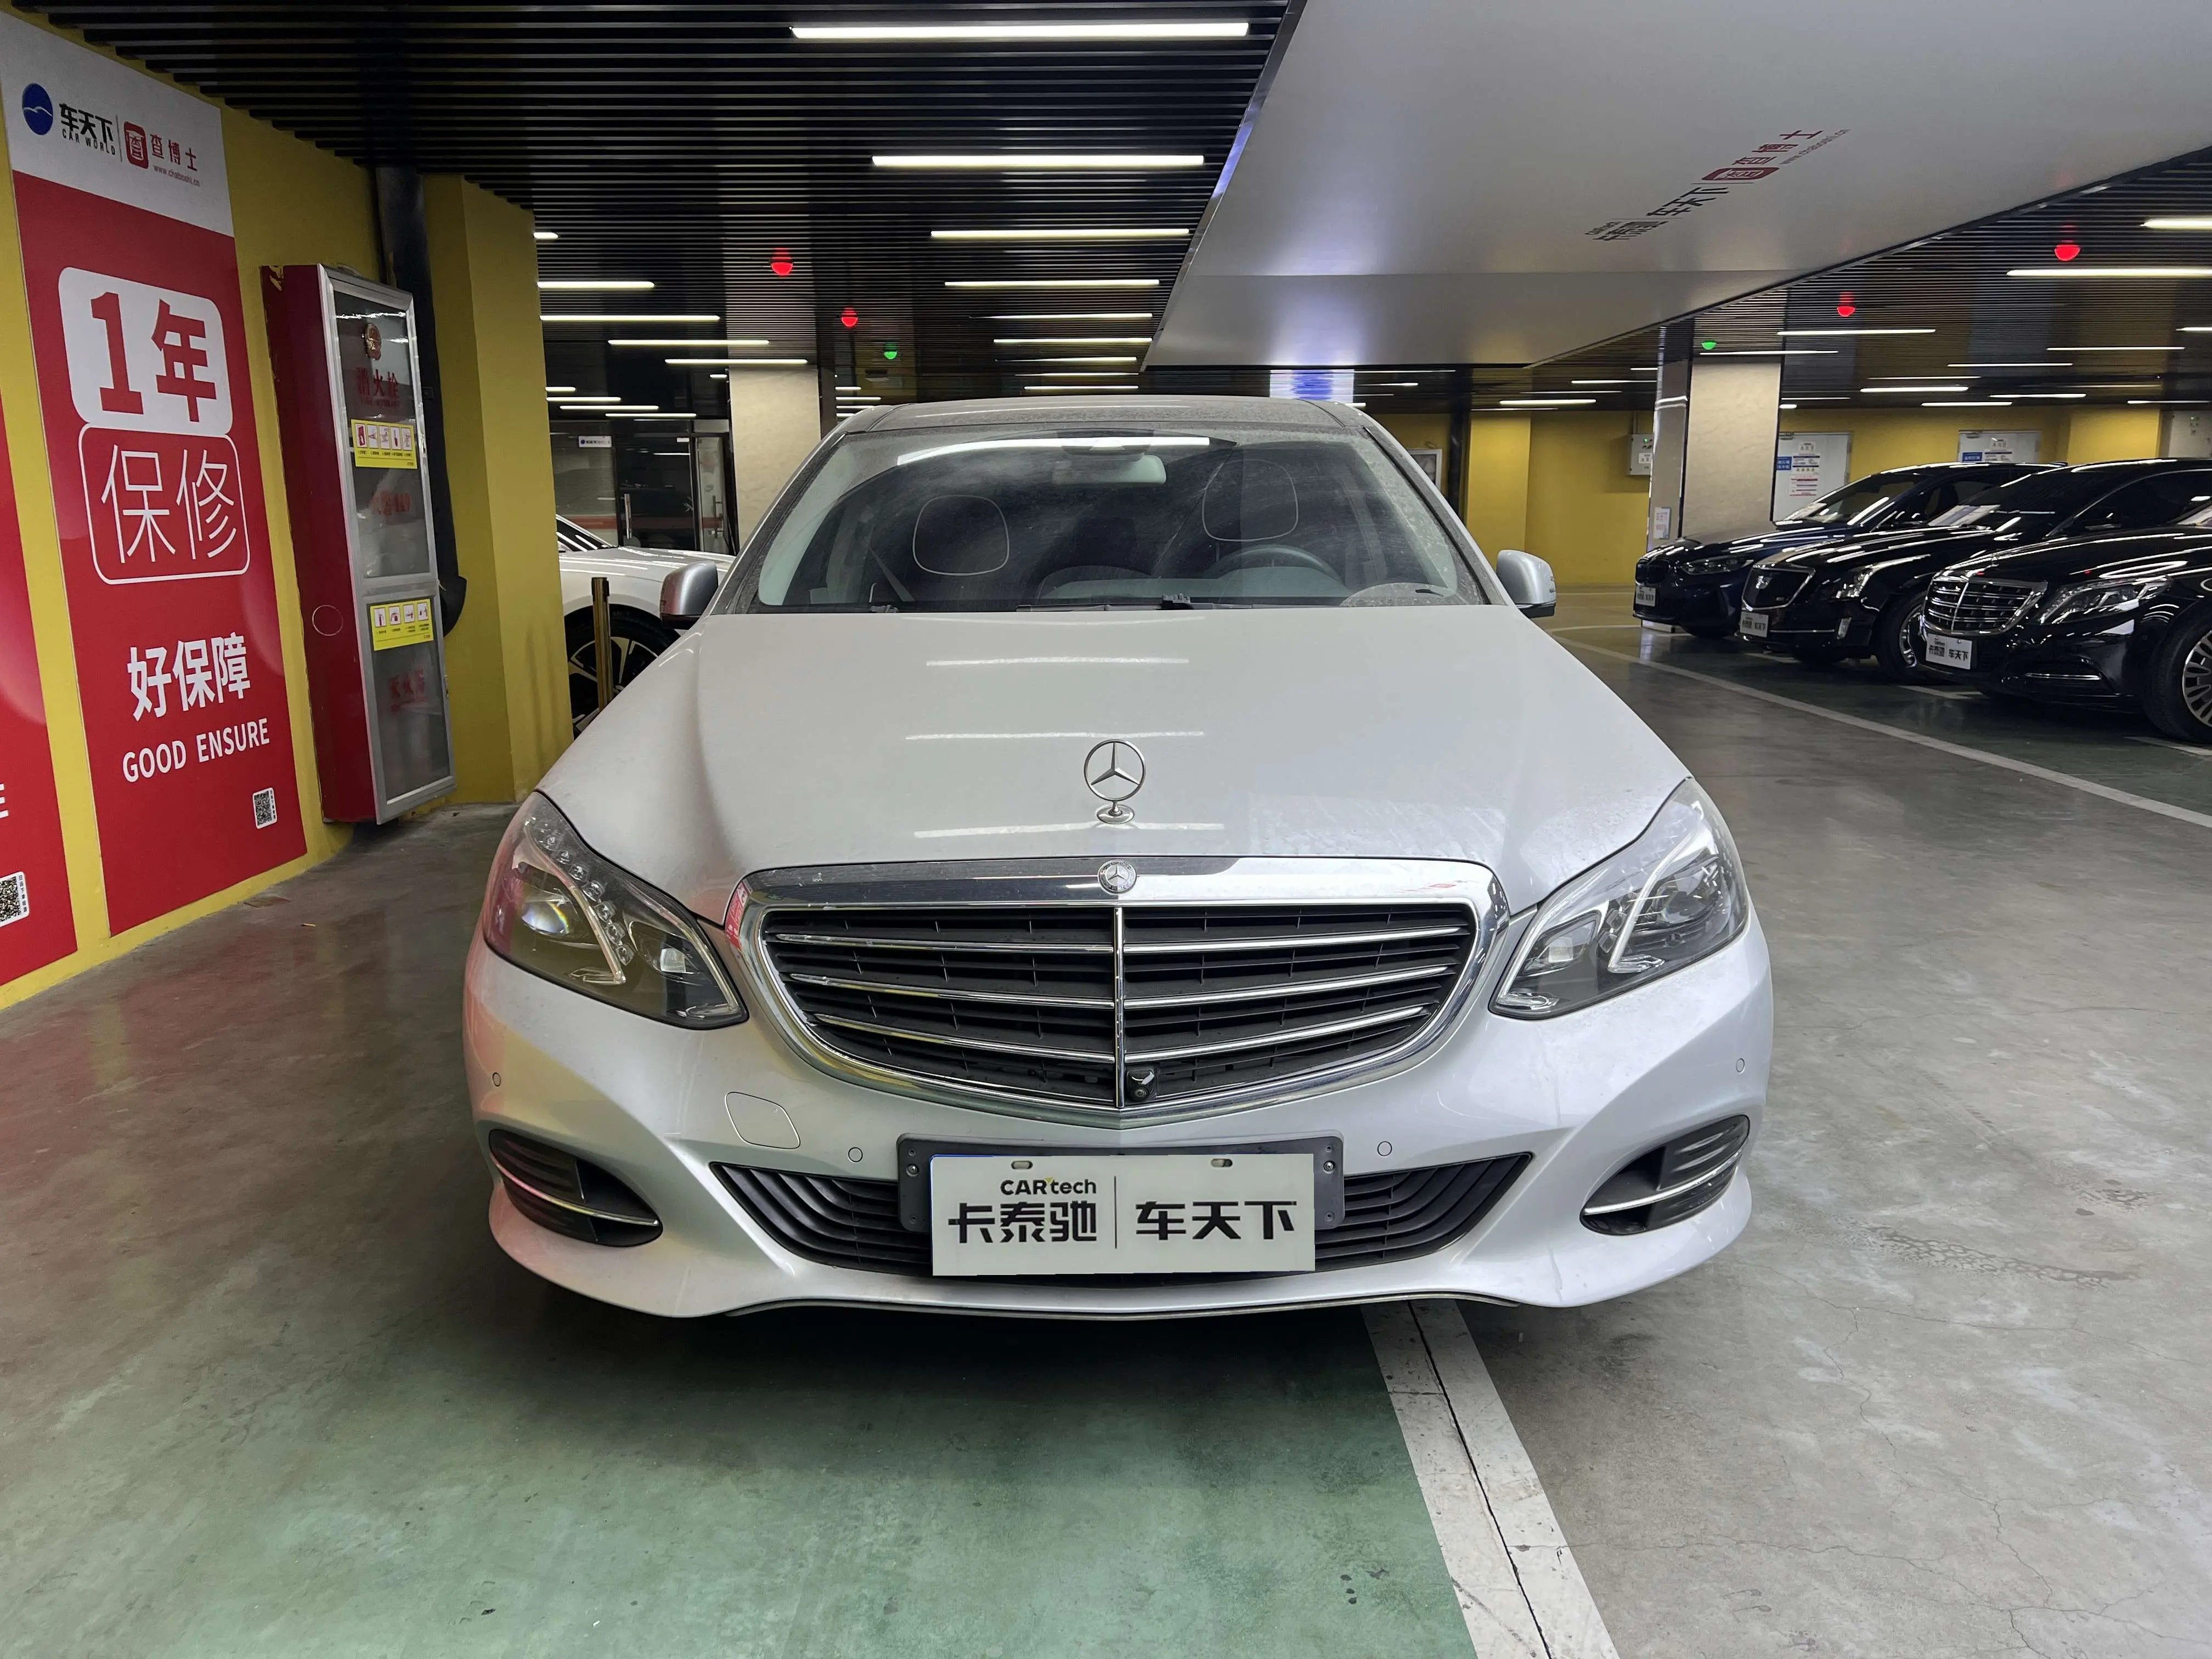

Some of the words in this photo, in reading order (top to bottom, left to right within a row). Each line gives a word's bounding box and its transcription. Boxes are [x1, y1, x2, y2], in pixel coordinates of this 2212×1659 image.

[59, 103, 114, 142] 车天下
[62, 128, 80, 144] CAR
[85, 136, 116, 155] WORLD
[149, 133, 198, 172] 查博士
[1646, 187, 1730, 216] 车天下
[90, 291, 217, 423] 1年
[100, 444, 237, 563] 保修
[127, 631, 251, 722] 好保障
[122, 740, 187, 783] GOOD
[196, 718, 270, 764] ENSURE
[1000, 1179, 1097, 1196] CARtech
[947, 1200, 1097, 1244] 卡泰驰
[1135, 1200, 1298, 1241] 车天下
